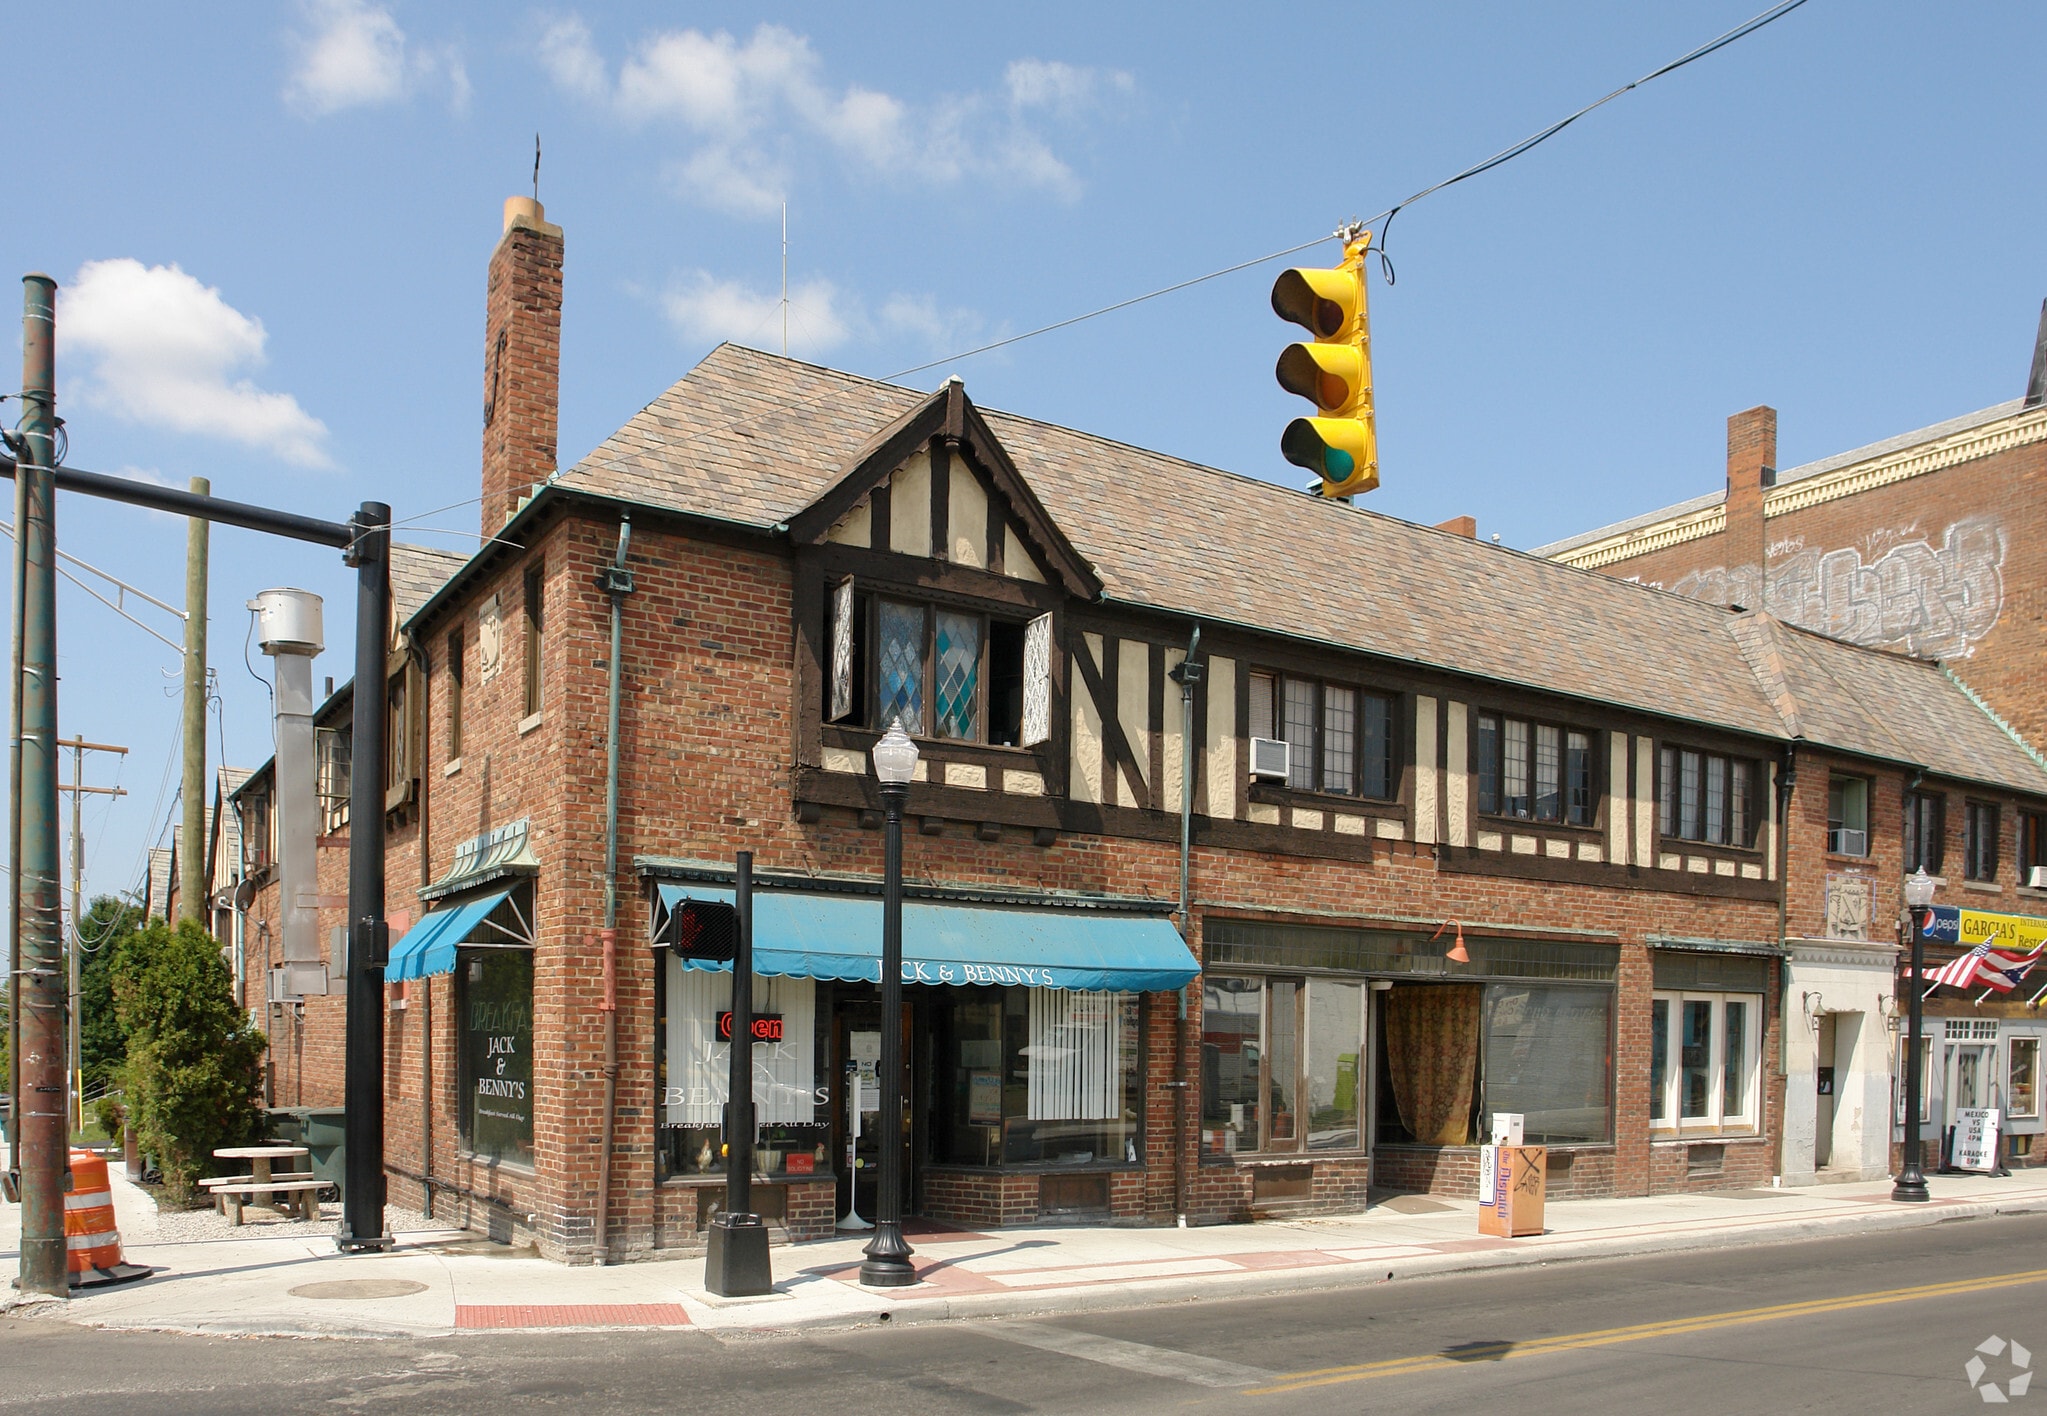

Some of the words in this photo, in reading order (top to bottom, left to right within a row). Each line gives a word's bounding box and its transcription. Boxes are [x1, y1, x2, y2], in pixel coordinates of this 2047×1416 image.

[1936, 917, 1959, 931] pepsi
[1963, 919, 2015, 939] GARCIA'S
[877, 959, 931, 981] JCK
[939, 965, 954, 980] &
[963, 964, 1053, 985] BENNY'S
[721, 1011, 784, 1039] Oen
[487, 1036, 515, 1058] JACK
[496, 1058, 506, 1075] &
[478, 1078, 525, 1100] BENNY'S
[661, 1086, 830, 1106] BENYS
[660, 1122, 720, 1131] Breakfas
[802, 1121, 830, 1130] Day
[1496, 1167, 1511, 1218] Dispatch
